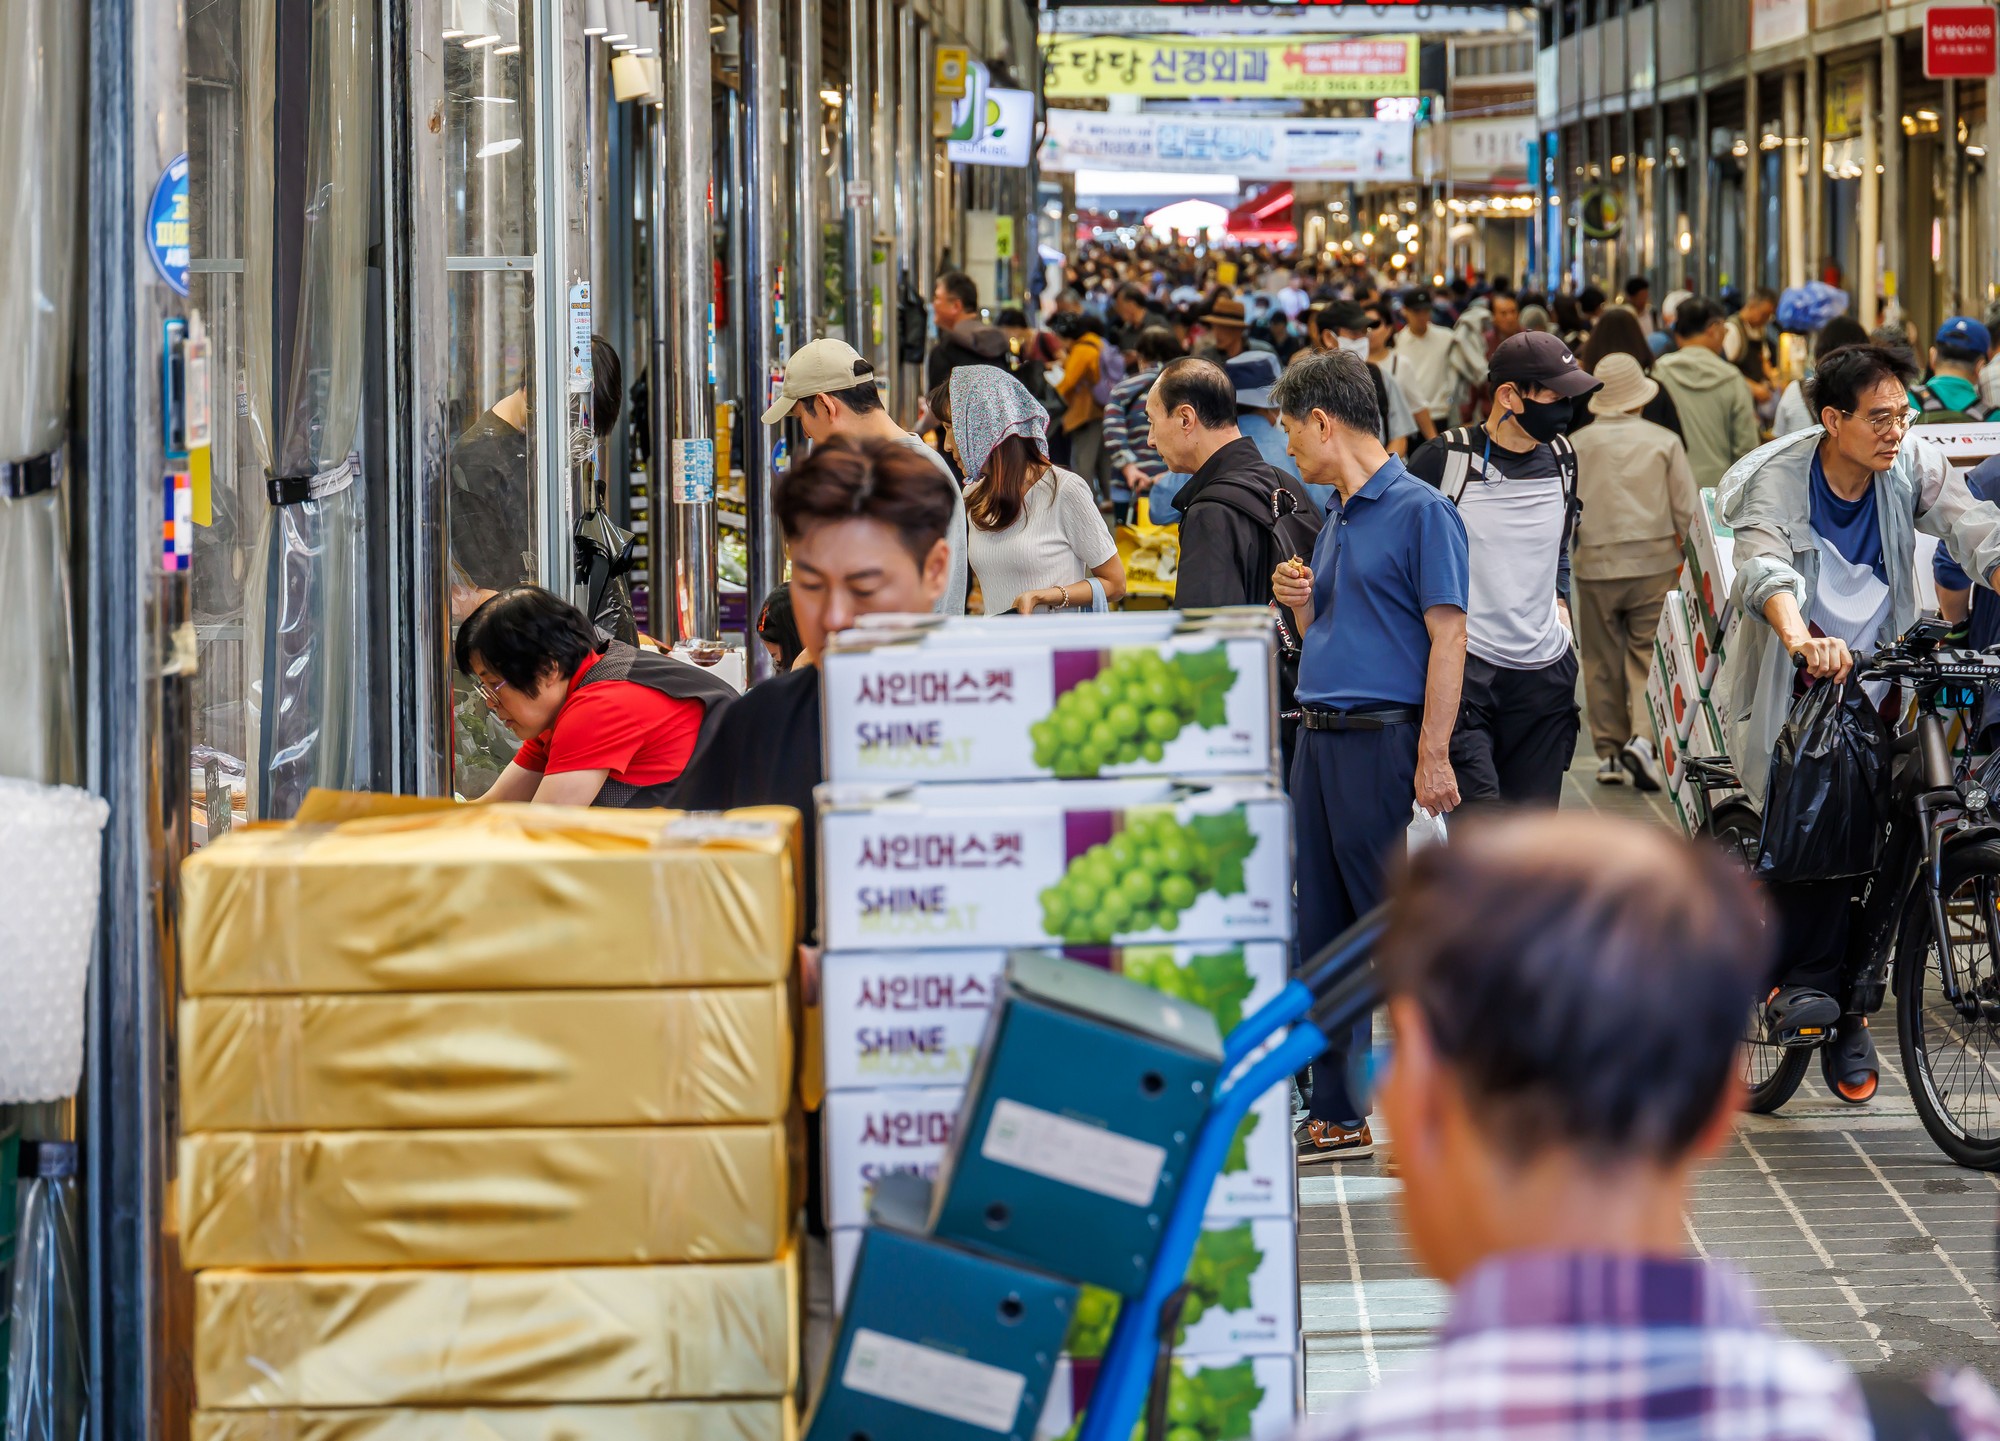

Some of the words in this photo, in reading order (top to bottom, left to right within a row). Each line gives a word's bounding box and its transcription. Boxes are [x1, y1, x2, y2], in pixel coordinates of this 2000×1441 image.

[1151, 48, 1270, 85] 신경외과
[1280, 631, 1293, 648] FILA
[856, 668, 1015, 705] 샤인머스켓
[857, 720, 942, 750] SHINE
[857, 738, 974, 768] MUSCAT
[857, 832, 1023, 870] 샤인머스켓
[857, 886, 946, 916] SHINE
[857, 903, 979, 935] MUSCAT
[856, 973, 999, 1011] 샤인머스
[856, 1026, 945, 1054] SHINE
